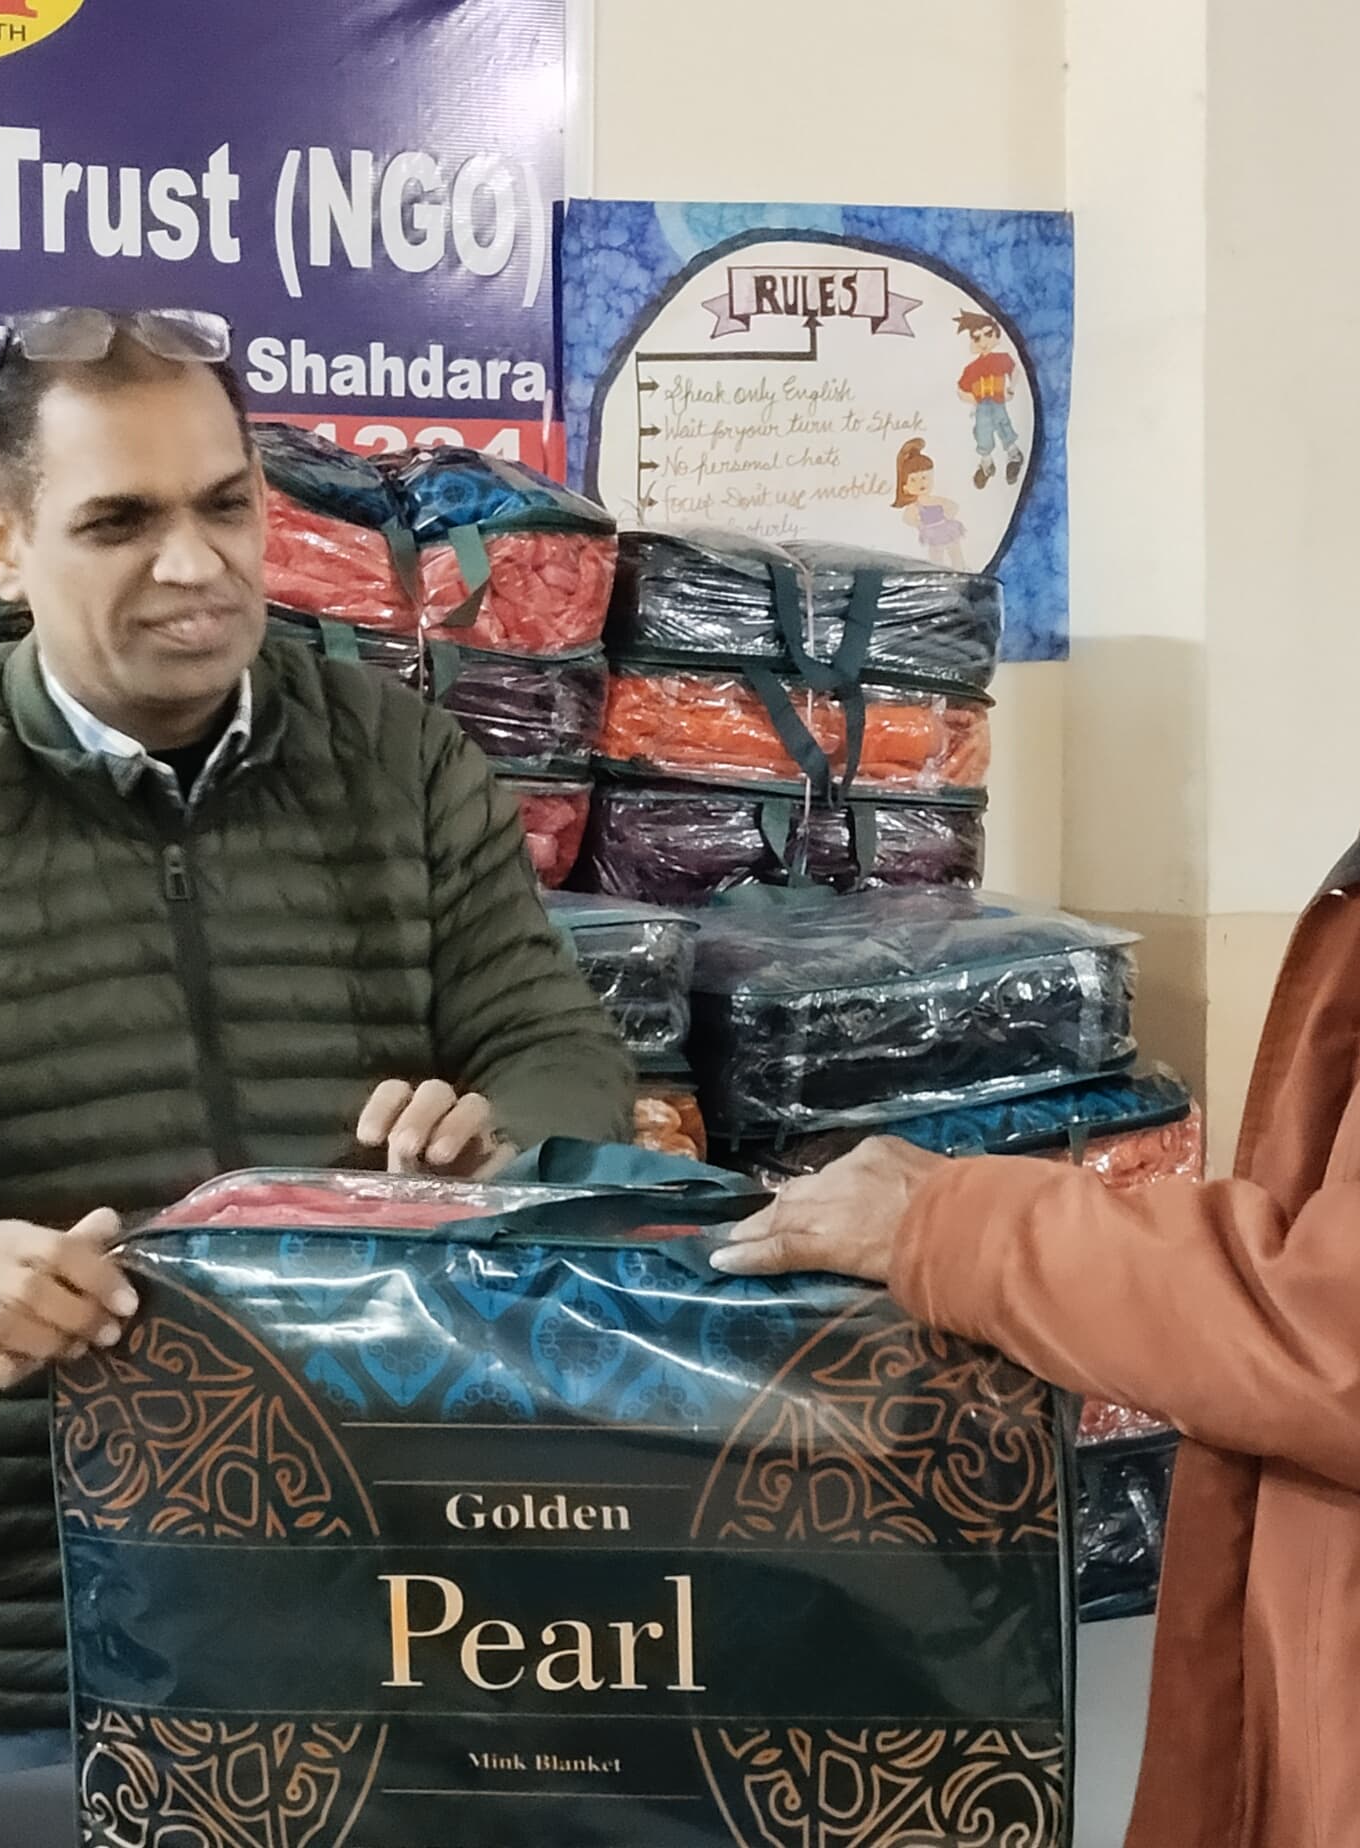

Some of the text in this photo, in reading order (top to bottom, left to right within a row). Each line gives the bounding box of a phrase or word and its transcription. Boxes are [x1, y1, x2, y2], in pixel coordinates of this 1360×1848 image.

[274, 148, 543, 309] (NGO)
[753, 272, 859, 316] RULES
[246, 336, 547, 402] Shahdara
[663, 374, 856, 423] Speak only English
[664, 414, 706, 442] Wait
[786, 411, 835, 437] turn
[840, 410, 865, 433] to
[663, 446, 689, 477] No
[689, 450, 782, 485] personal
[776, 489, 808, 511] use
[809, 473, 893, 501] mobile
[445, 1492, 631, 1532] Golden
[377, 1573, 706, 1693] Pearl
[468, 1752, 623, 1773] Mink Blanket
